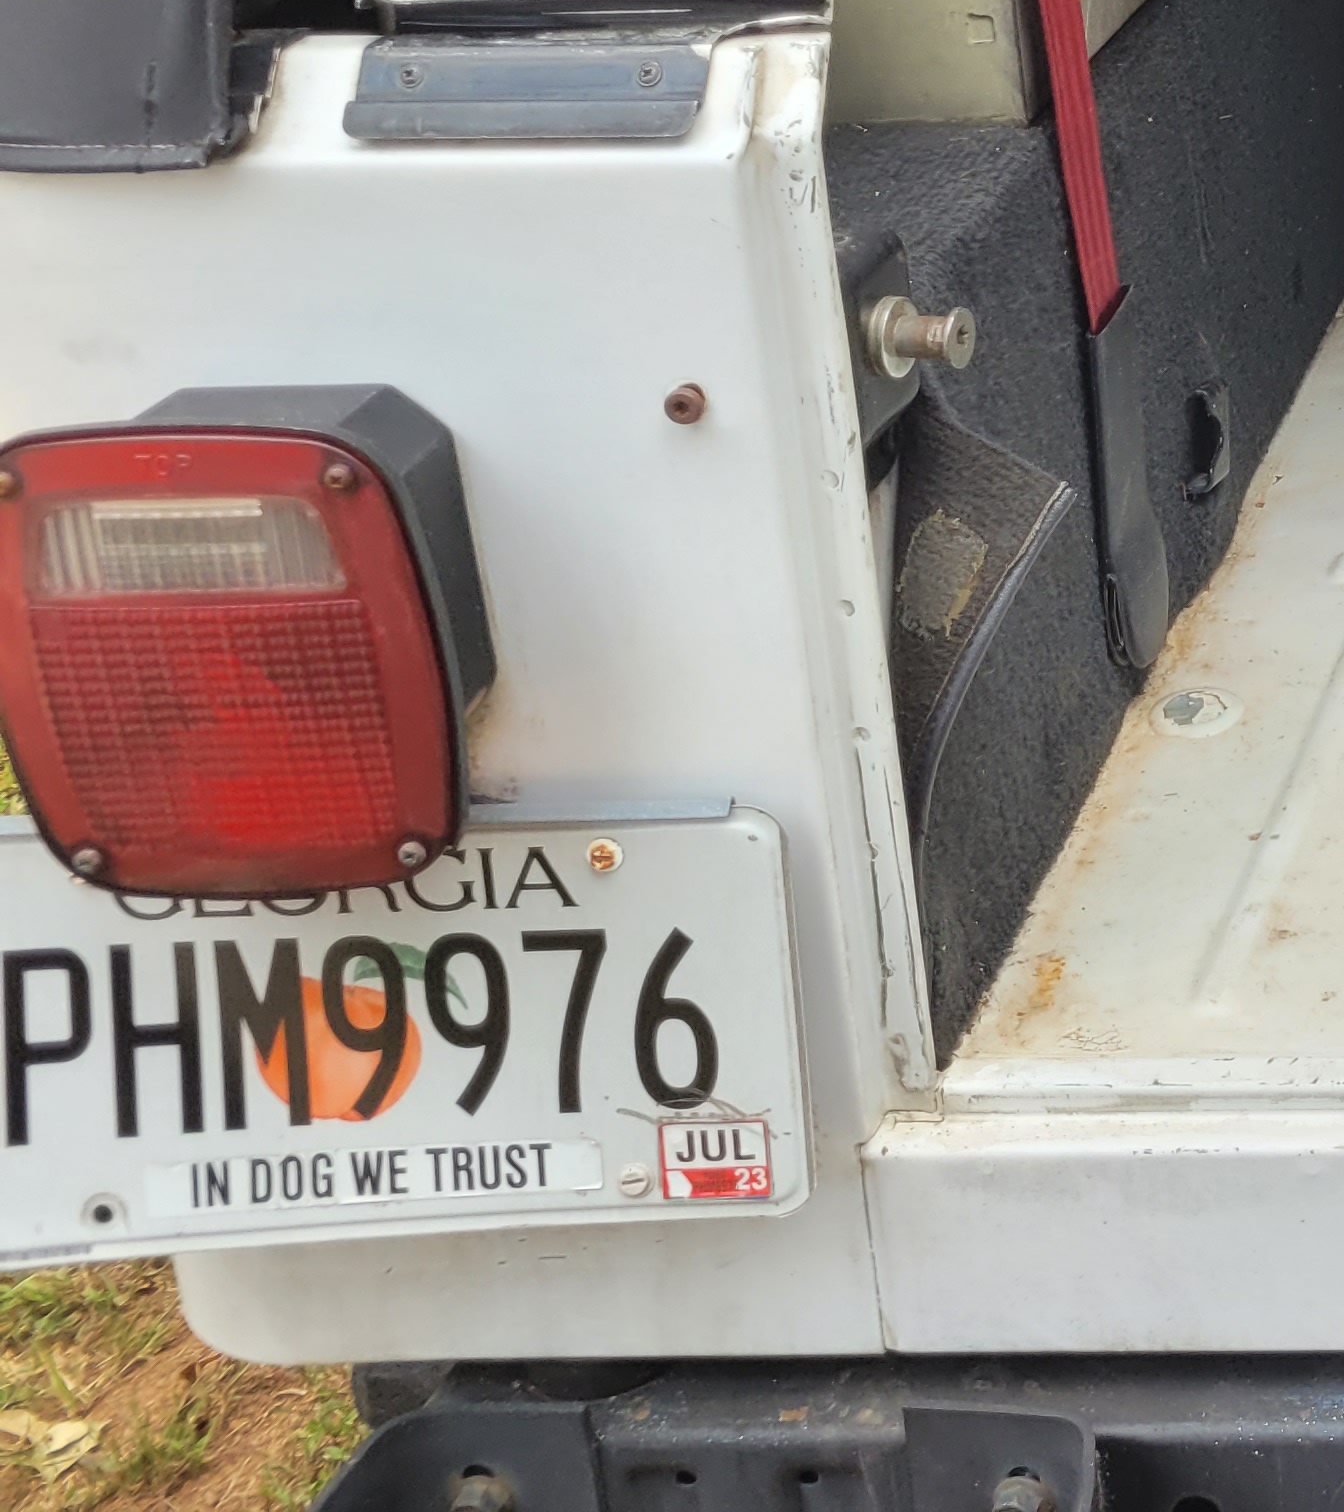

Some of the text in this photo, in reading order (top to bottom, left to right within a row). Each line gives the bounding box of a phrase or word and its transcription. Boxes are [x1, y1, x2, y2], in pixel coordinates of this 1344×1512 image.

[133, 453, 191, 475] TOP
[2, 926, 720, 1147] PHM9976
[675, 1128, 756, 1163] JUL
[191, 1142, 553, 1208] IN DOG WE TRUST
[733, 1167, 768, 1191] 23
